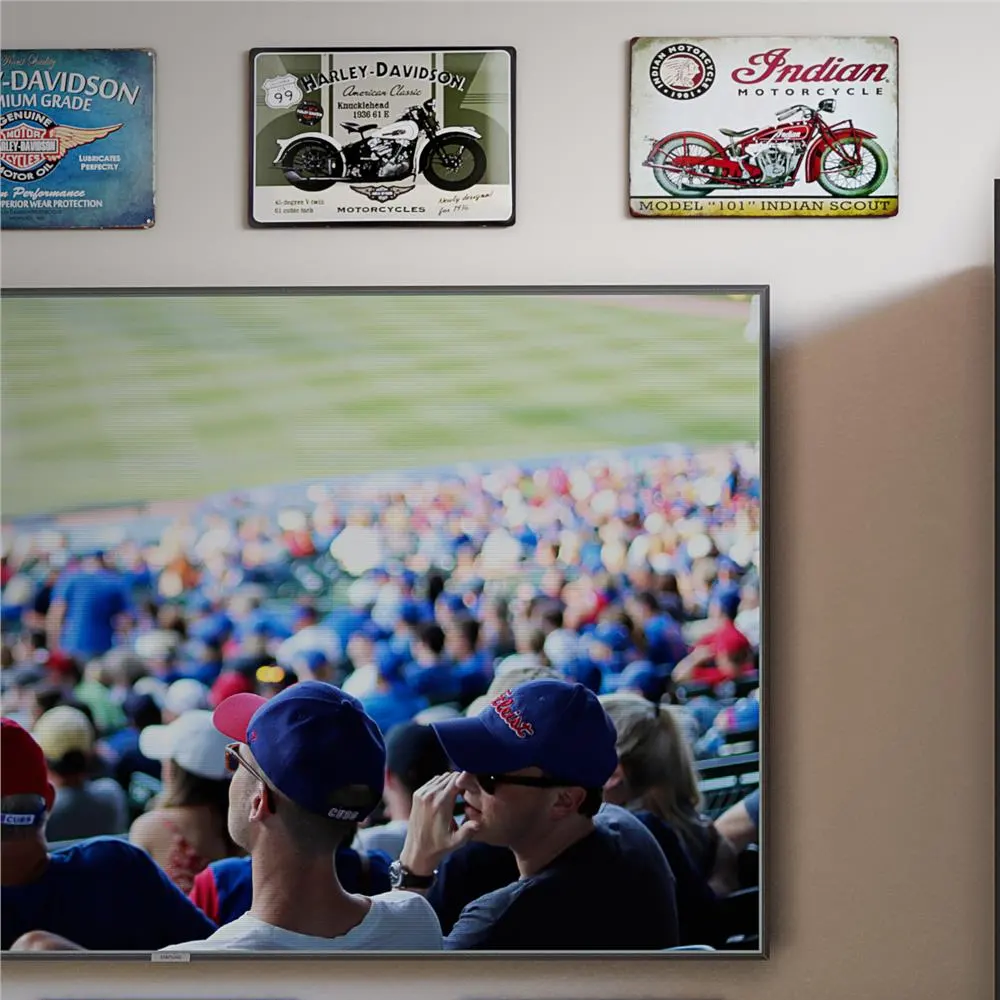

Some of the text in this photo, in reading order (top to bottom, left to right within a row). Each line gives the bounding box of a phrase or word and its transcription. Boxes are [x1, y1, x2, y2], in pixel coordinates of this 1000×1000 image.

[651, 45, 714, 89] INDIAN MOTORCYCLE
[731, 48, 890, 84] Indian
[274, 90, 293, 103] 99
[342, 84, 423, 97] American Classic
[671, 91, 695, 99] 1901
[738, 87, 883, 96] MOTORCYCLE
[41, 94, 93, 112] GRADE
[337, 101, 389, 110] Knucklehead
[0, 111, 53, 128] GENUINE
[353, 111, 372, 119] 1936
[6, 129, 41, 138] MOTOR
[5, 154, 41, 168] CYCLES
[36, 163, 54, 177] OIL
[12, 186, 86, 200] Performance
[29, 200, 52, 208] WEAR
[53, 200, 103, 209] PROTECTION
[639, 201, 703, 211] MODEL
[761, 201, 823, 211] INDIAN
[830, 200, 890, 211] SCOUT
